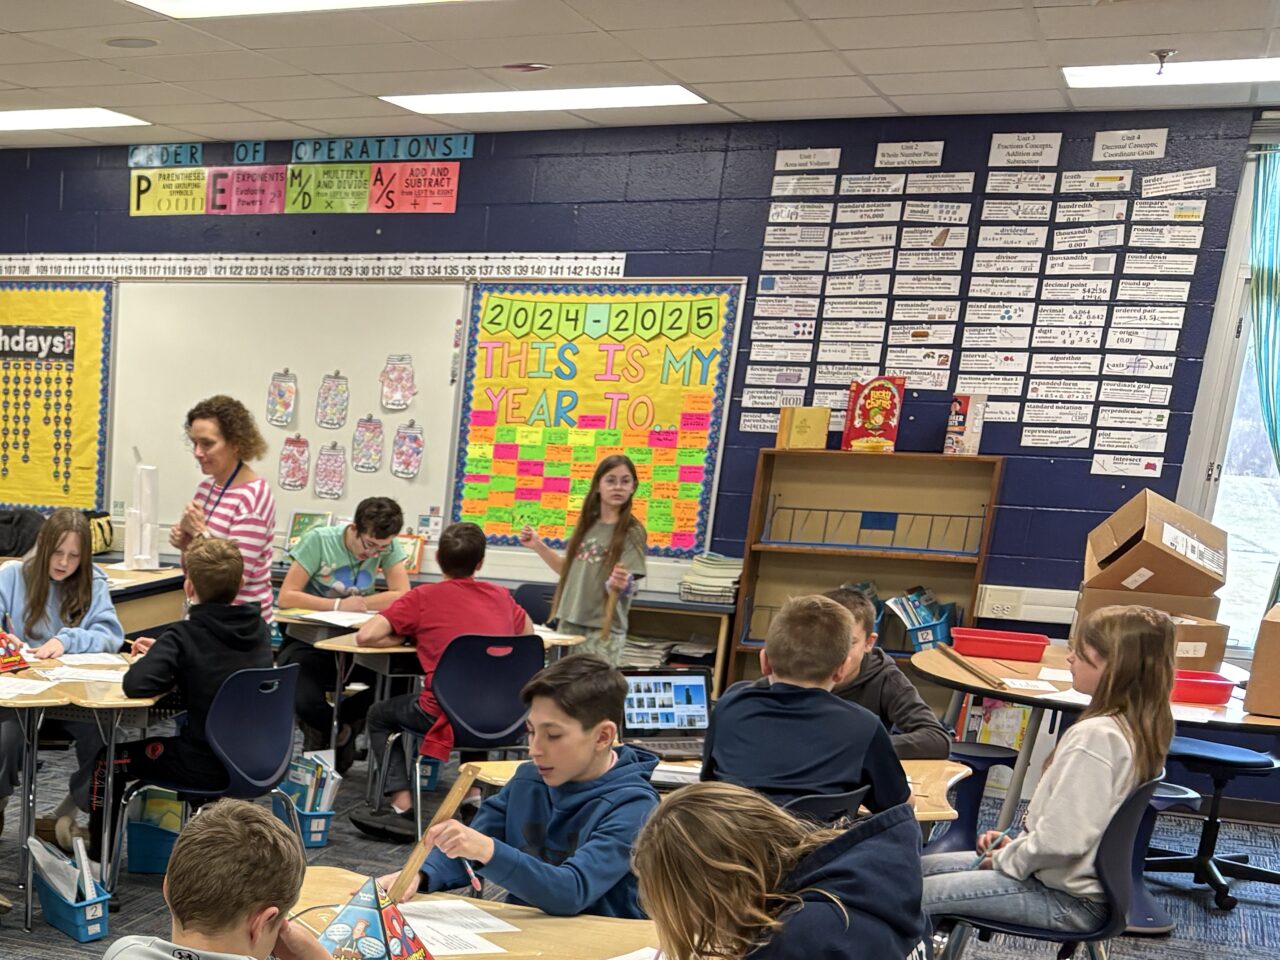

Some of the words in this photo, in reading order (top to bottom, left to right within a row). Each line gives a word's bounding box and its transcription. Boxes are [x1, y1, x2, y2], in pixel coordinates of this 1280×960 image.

[236, 143, 261, 161] OF
[158, 172, 205, 181] PARENTHESES
[236, 172, 284, 182] EXPONENTS
[323, 170, 364, 179] MULTIPLY
[410, 168, 427, 177] ADD
[431, 168, 449, 177] AND
[317, 180, 335, 189] AND
[338, 179, 368, 189] DIVIDE
[405, 178, 451, 187] SUBTRACT
[137, 175, 151, 210] P
[212, 173, 228, 209] E
[479, 342, 579, 380] THIS
[595, 344, 649, 382] IS
[661, 345, 720, 385] MY
[871, 390, 891, 402] Lucky
[485, 387, 578, 427] YEAR
[865, 399, 892, 410] Charms
